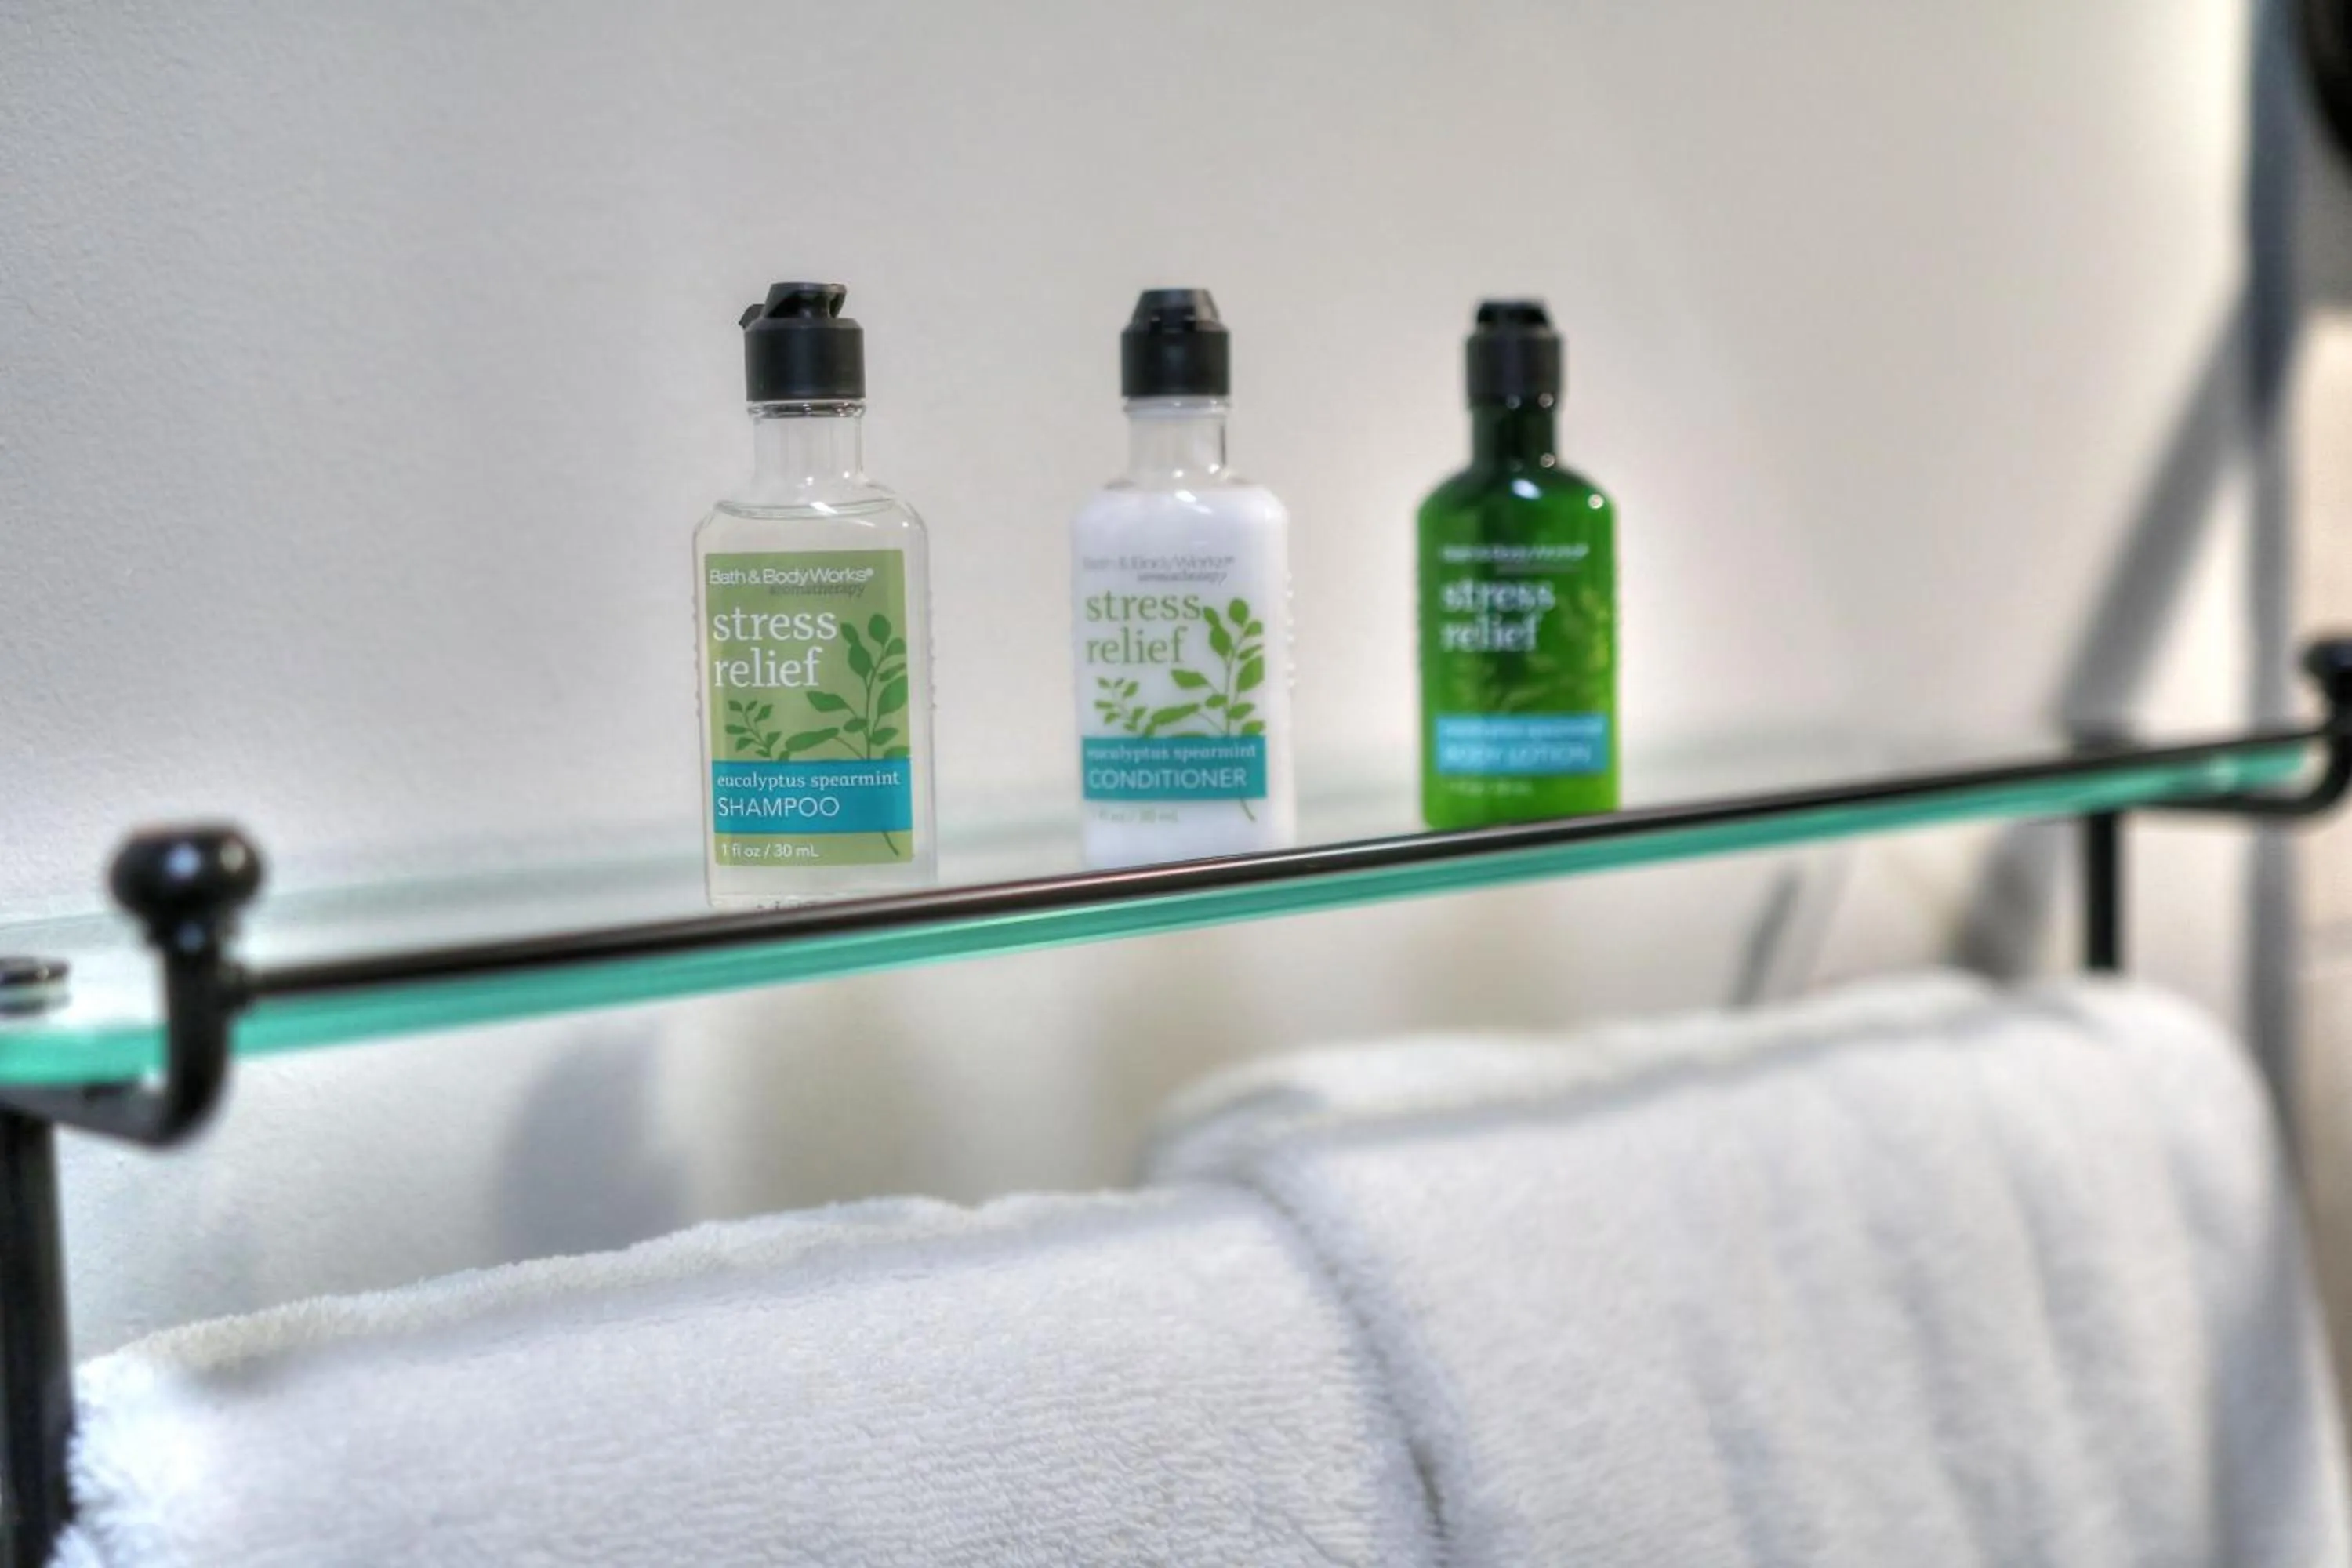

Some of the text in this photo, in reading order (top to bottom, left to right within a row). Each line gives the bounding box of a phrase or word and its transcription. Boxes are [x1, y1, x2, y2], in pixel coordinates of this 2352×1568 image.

[709, 569, 746, 585] Bath
[747, 569, 761, 584] &
[1086, 590, 1201, 622] stress
[1443, 580, 1555, 612] stress
[713, 606, 837, 641] stress
[1442, 615, 1544, 652] relief
[1087, 626, 1189, 664] relief
[714, 646, 823, 688] relief
[717, 770, 901, 791] eucalyptus spearmint
[1089, 768, 1247, 789] CONDITIONER
[717, 796, 840, 818] SHAMPOO
[743, 847, 760, 858] oz
[763, 843, 771, 860] /
[773, 844, 793, 858] 30
[796, 843, 820, 858] mL
